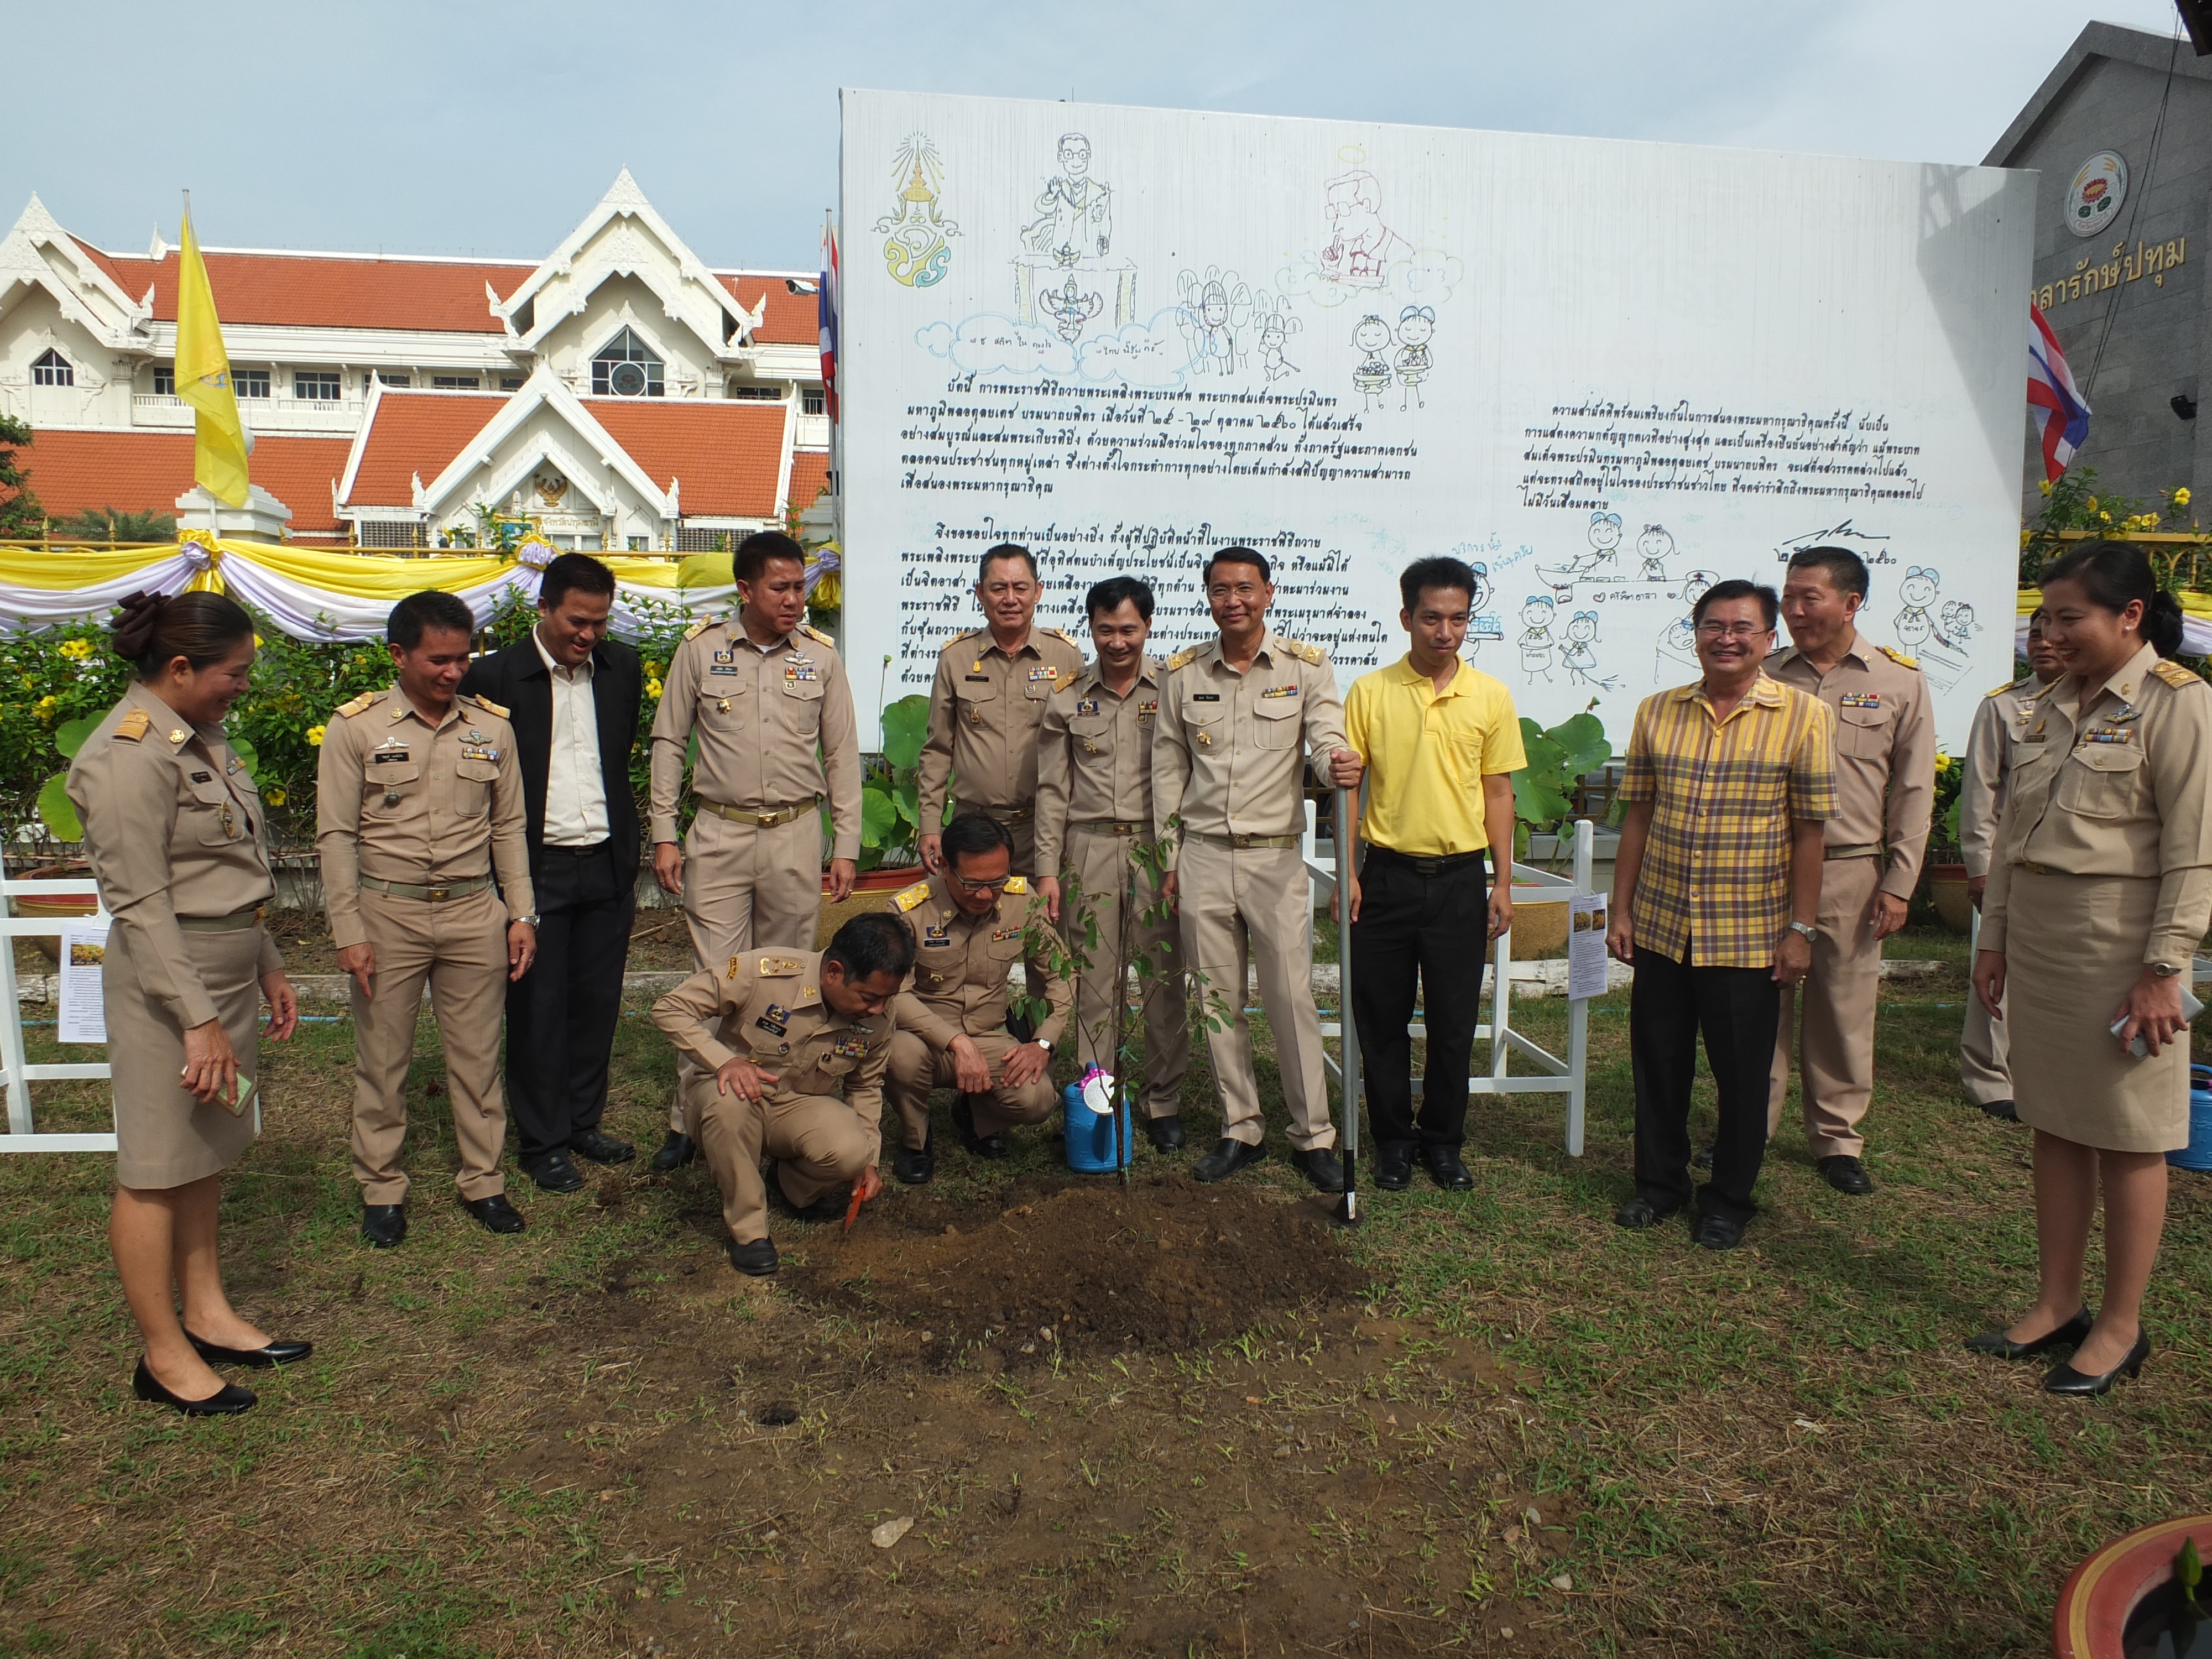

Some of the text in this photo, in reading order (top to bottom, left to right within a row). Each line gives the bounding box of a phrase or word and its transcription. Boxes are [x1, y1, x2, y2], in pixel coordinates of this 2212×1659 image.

[947, 371, 977, 393] บัดนี้
[1199, 386, 1337, 408] พระบาทสมเด็จพระปรมินทร
[907, 400, 1019, 424] มหาภูมิพลอดุลยเดช
[1022, 405, 1095, 422] บรมนาถบพิตร
[1102, 403, 1148, 425] เมื่อวันที่
[1217, 416, 1254, 434] ตุลาคม
[1858, 411, 1889, 431] นับเป็น
[901, 447, 1060, 475] ตลอดจนประชาชนทุกหมู่เหล่า
[1714, 456, 1778, 471] บรมนาถบพิตร
[901, 469, 1053, 499] เพื่อสนองพระมหากรุณาธิคุณ
[901, 593, 961, 612] พระราชพิธี
